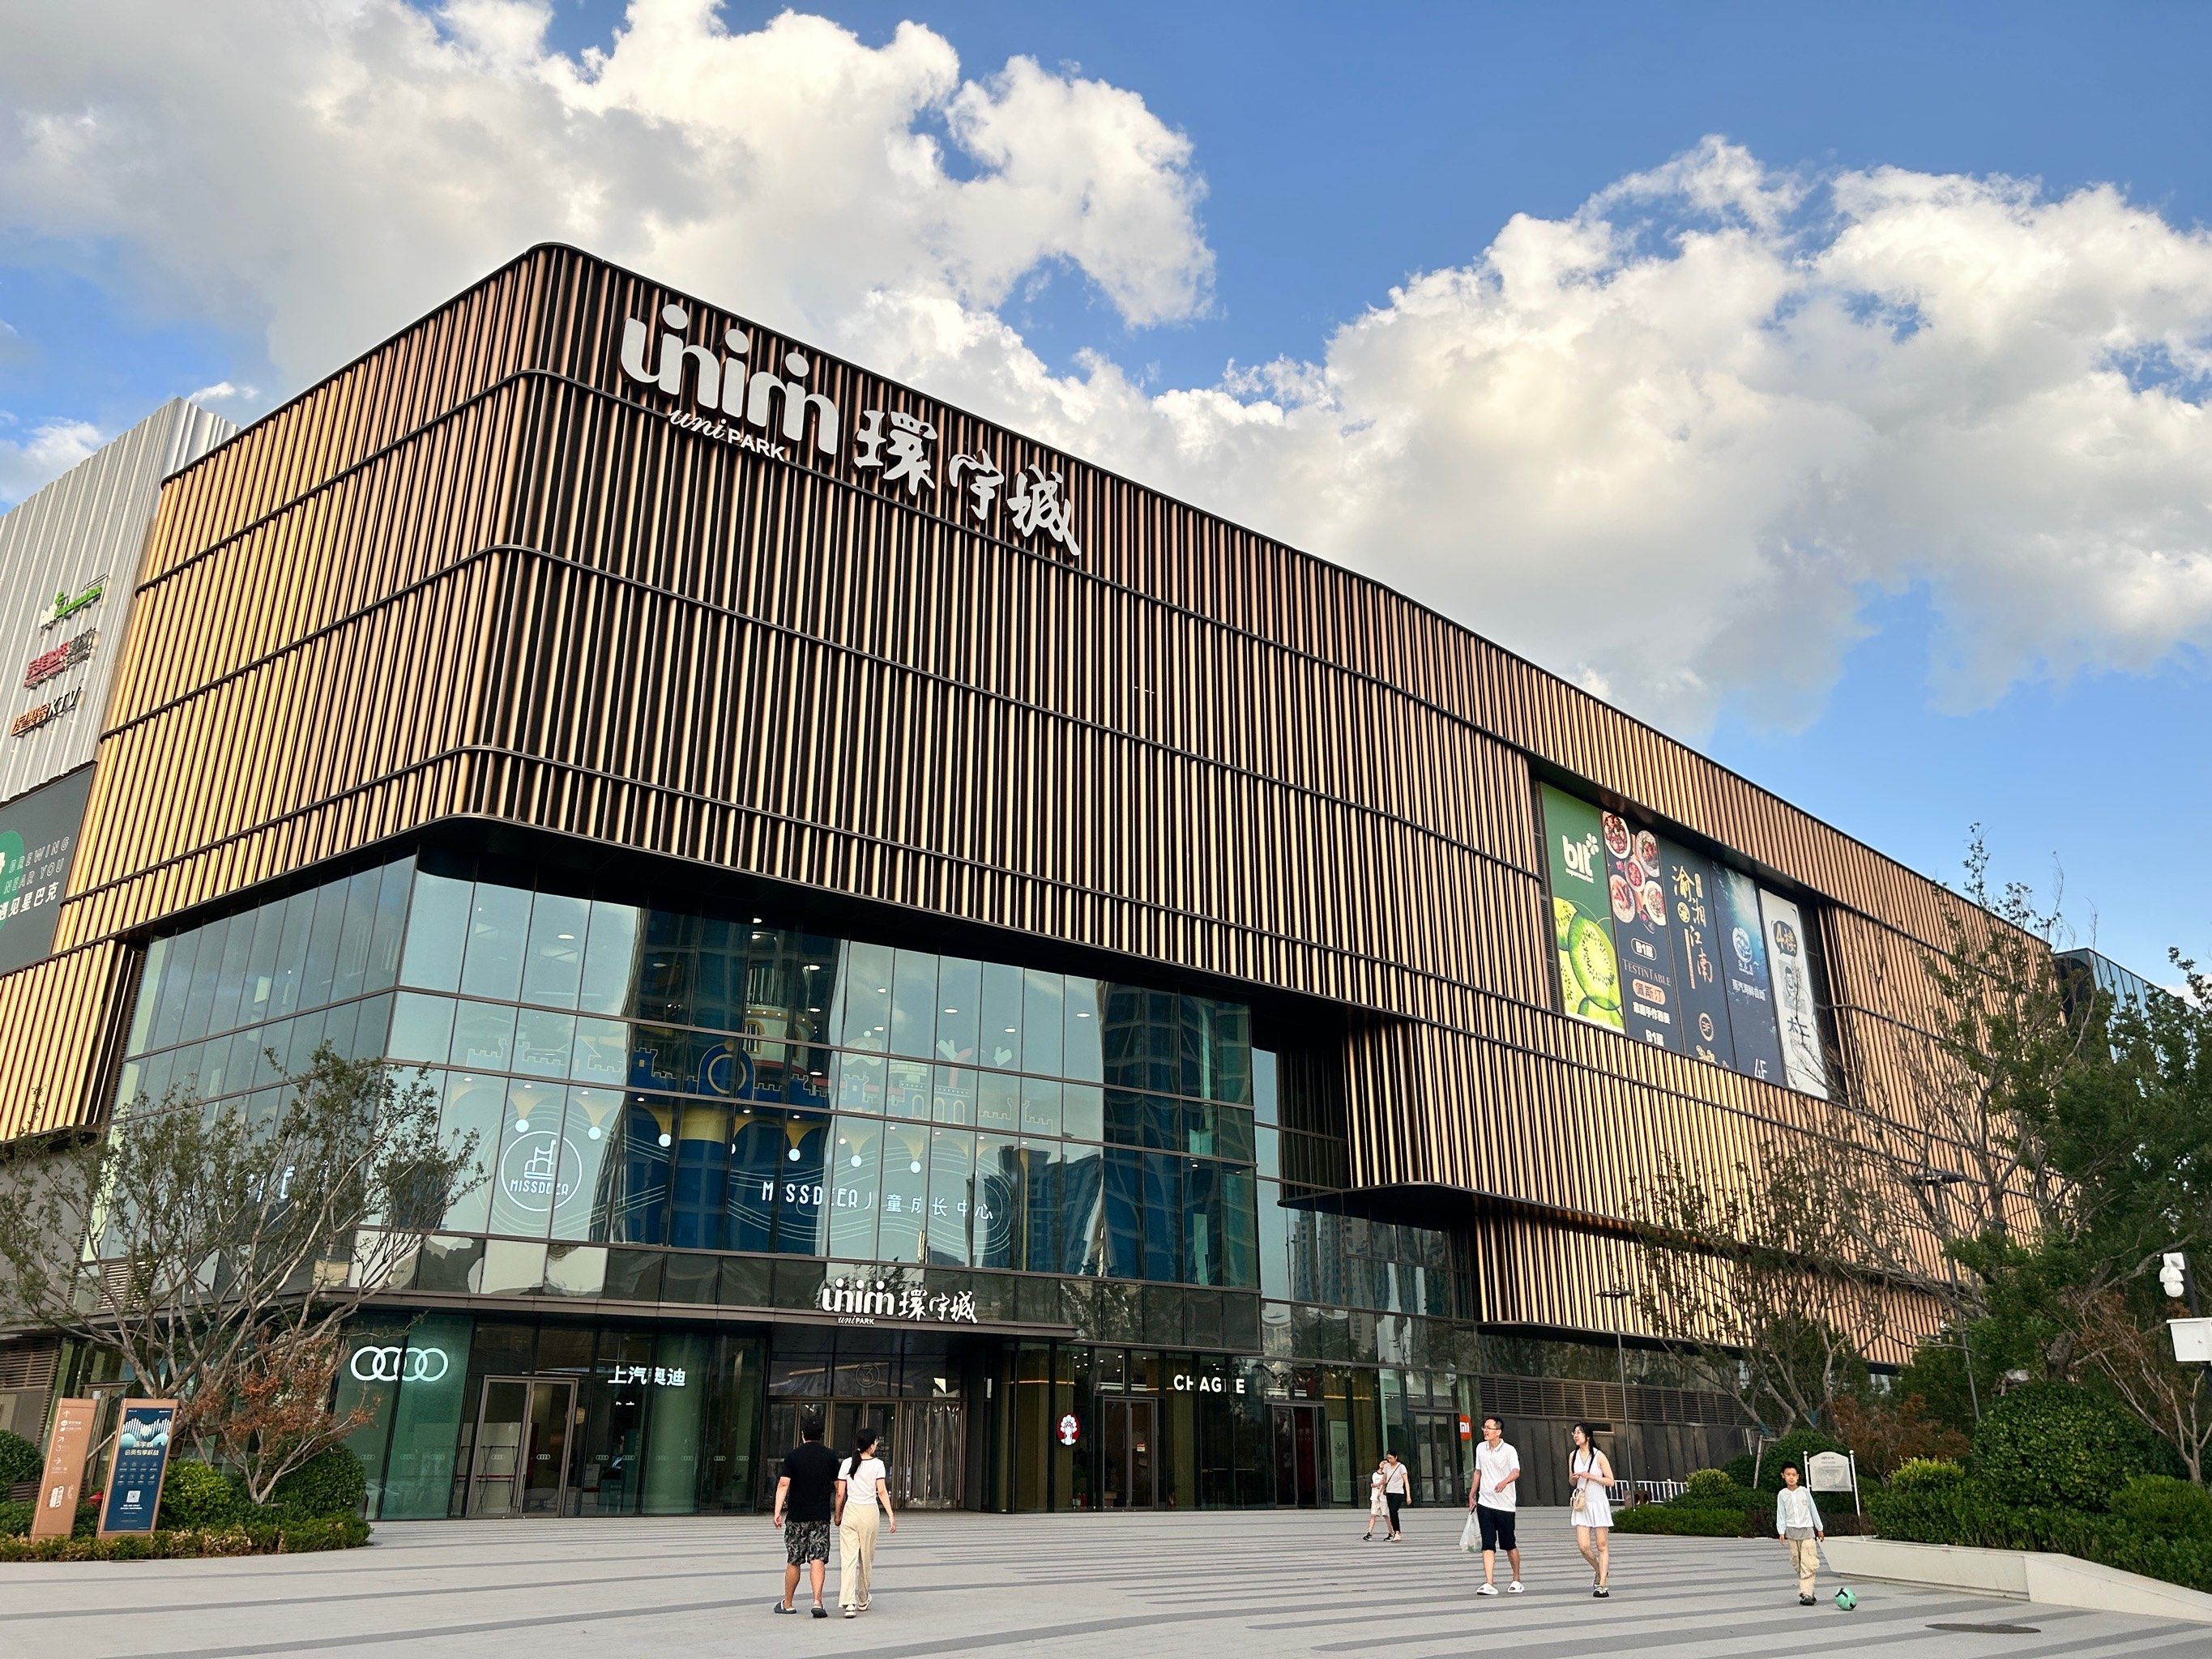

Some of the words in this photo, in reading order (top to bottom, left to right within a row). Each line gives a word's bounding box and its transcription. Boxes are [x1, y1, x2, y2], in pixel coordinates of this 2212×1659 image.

[9, 836, 70, 873] BREWING
[3, 870, 35, 895] NEAR
[40, 858, 65, 880] YOU
